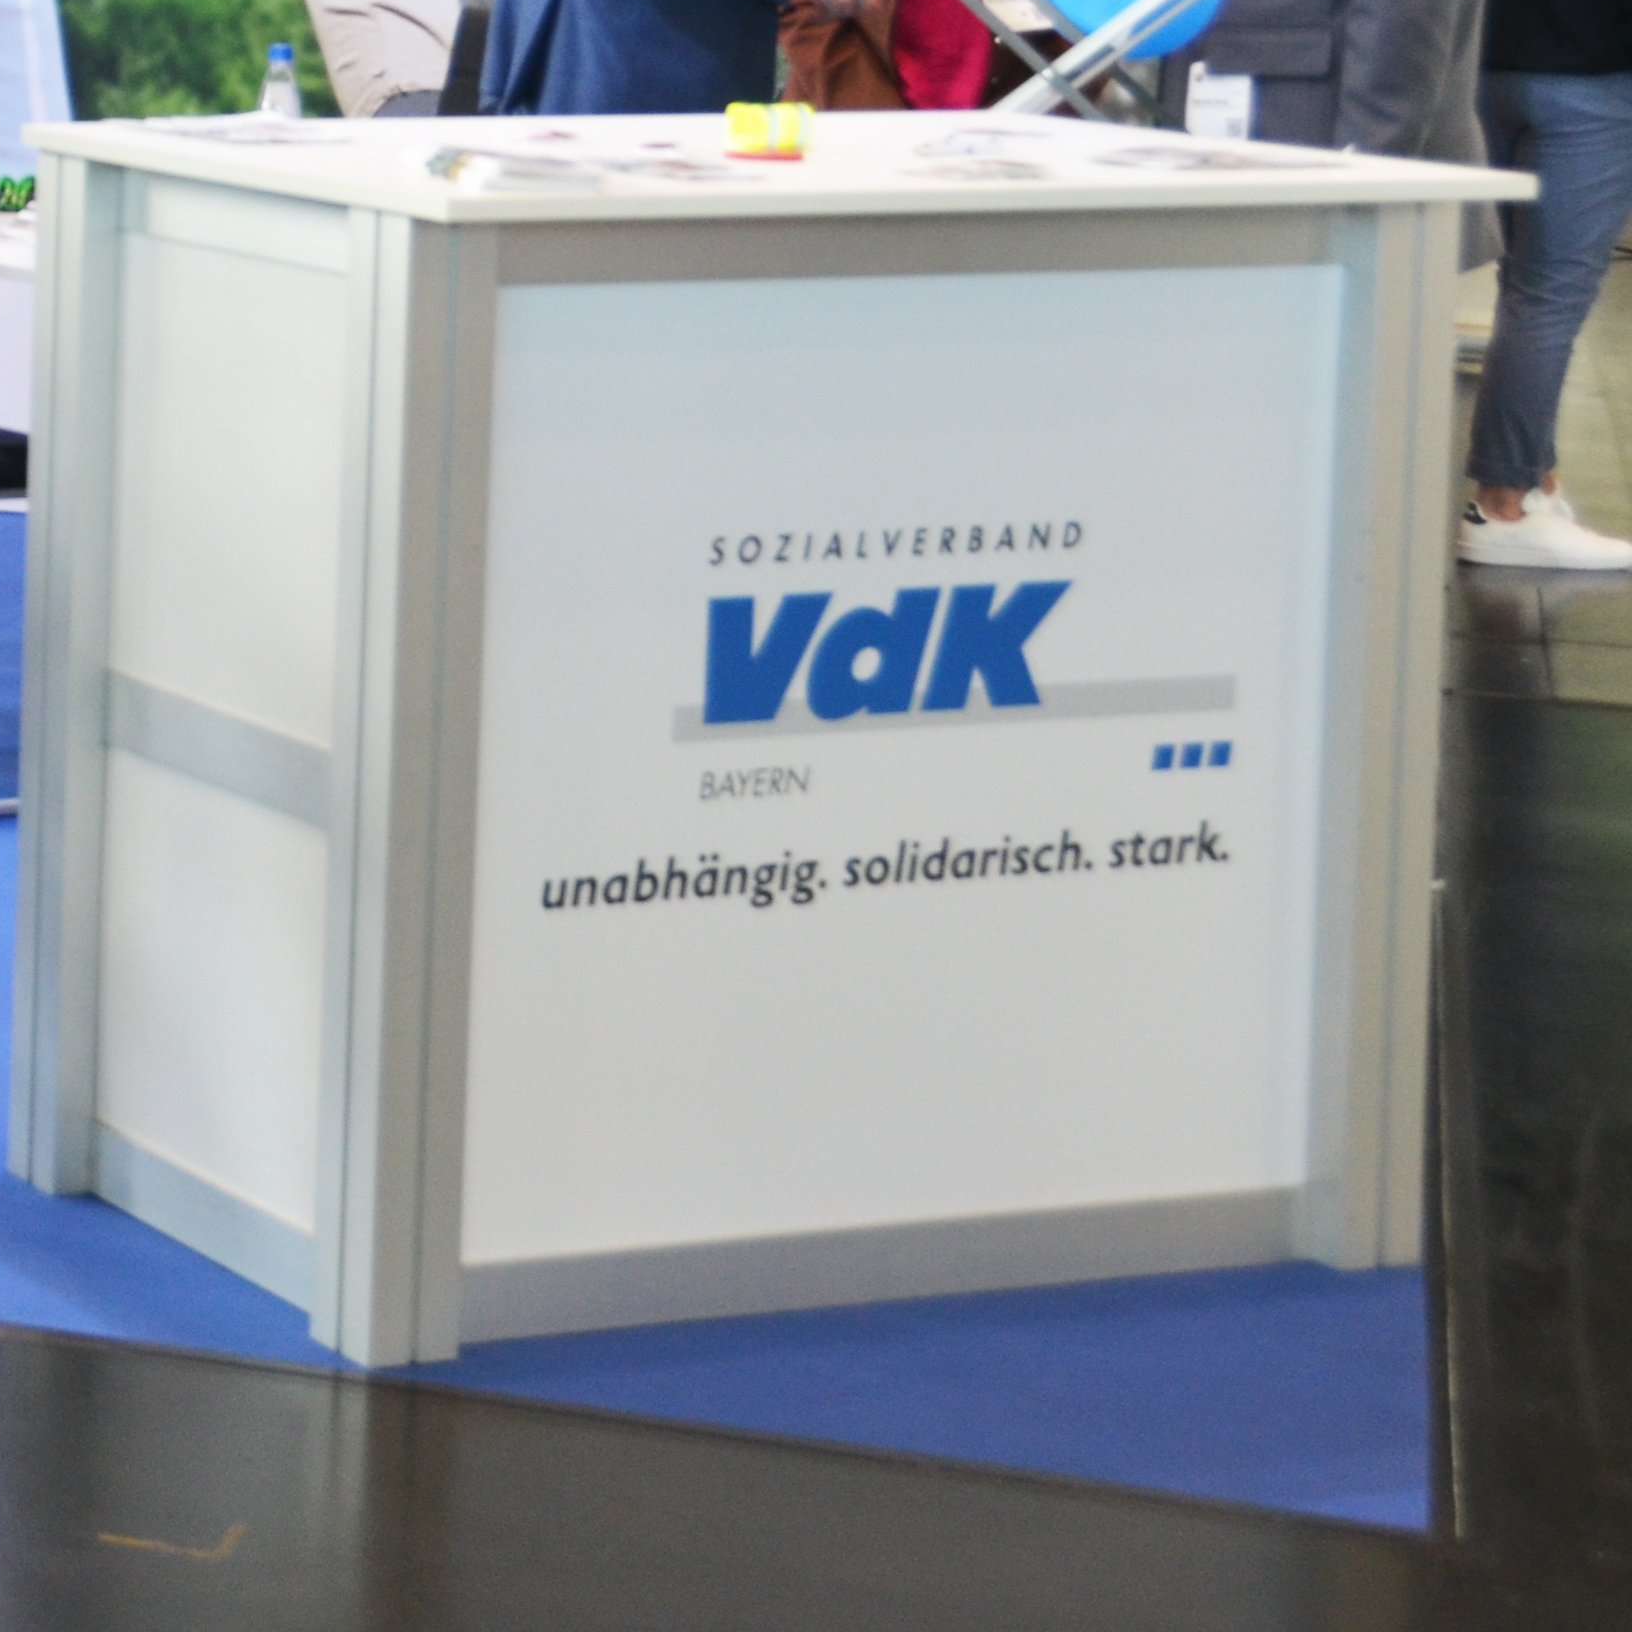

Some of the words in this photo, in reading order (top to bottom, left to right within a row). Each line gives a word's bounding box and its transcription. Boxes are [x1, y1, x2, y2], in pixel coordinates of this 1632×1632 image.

[708, 521, 1086, 567] SOZIALVERBAND
[703, 580, 1073, 725] VdK
[699, 767, 811, 802] BAYERN
[541, 851, 828, 910] unabhängig.
[841, 830, 1093, 888] solidarisch.
[1107, 821, 1230, 869] stark.
